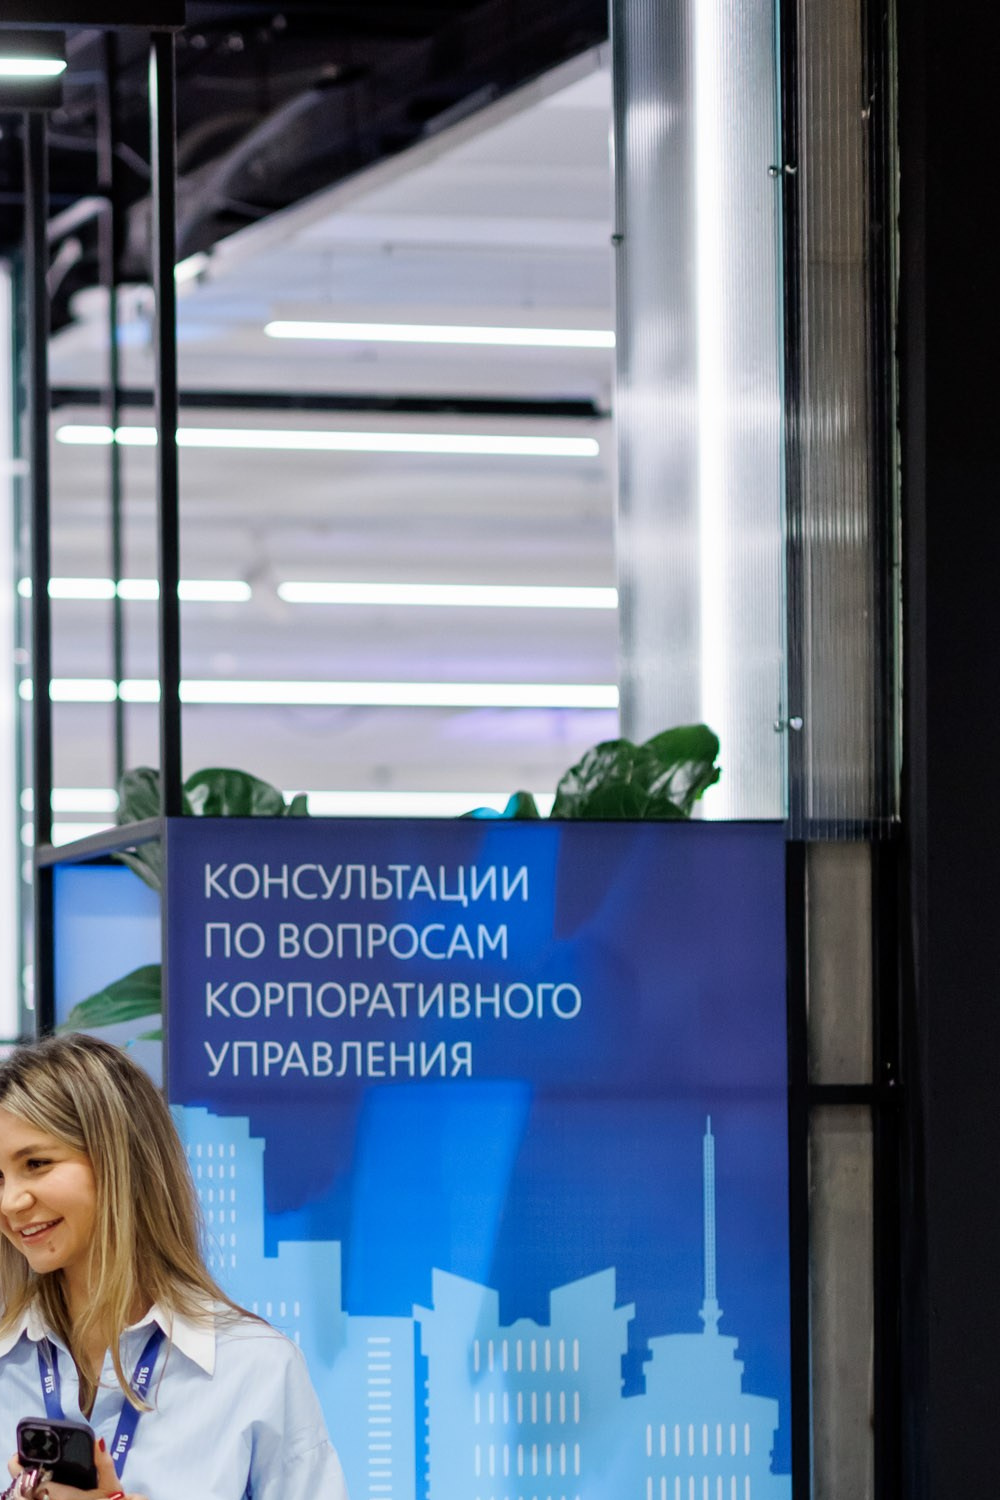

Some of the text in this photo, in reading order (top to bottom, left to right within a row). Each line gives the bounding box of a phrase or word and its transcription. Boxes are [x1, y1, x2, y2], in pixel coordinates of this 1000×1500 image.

[204, 863, 529, 907] КОНСУЛЬТАЦИИ
[204, 922, 508, 960] ПО ВОПРОСАМ
[205, 982, 582, 1019] КОРПОРАТИВНОГО
[203, 1040, 473, 1077] УПРАВЛЕНИЯ
[44, 1375, 55, 1394] ВТБ
[137, 1366, 150, 1385] ВТБ
[116, 1434, 129, 1453] ВТБ
